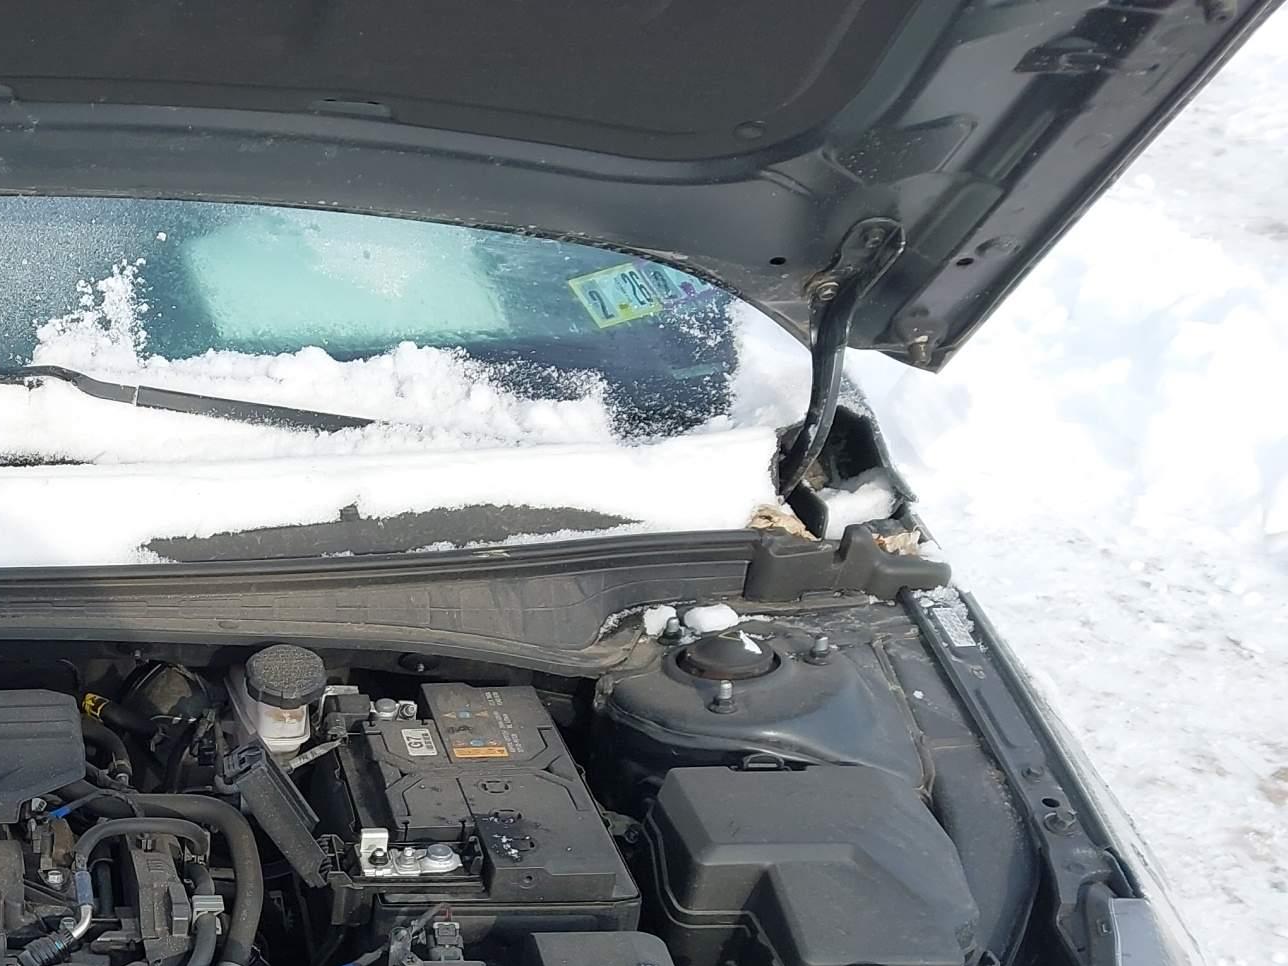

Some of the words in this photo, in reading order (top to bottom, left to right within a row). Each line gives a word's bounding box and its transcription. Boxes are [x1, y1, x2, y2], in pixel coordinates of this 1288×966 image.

[588, 290, 615, 319] 2
[621, 271, 653, 305] 26
[408, 736, 424, 749] G7
